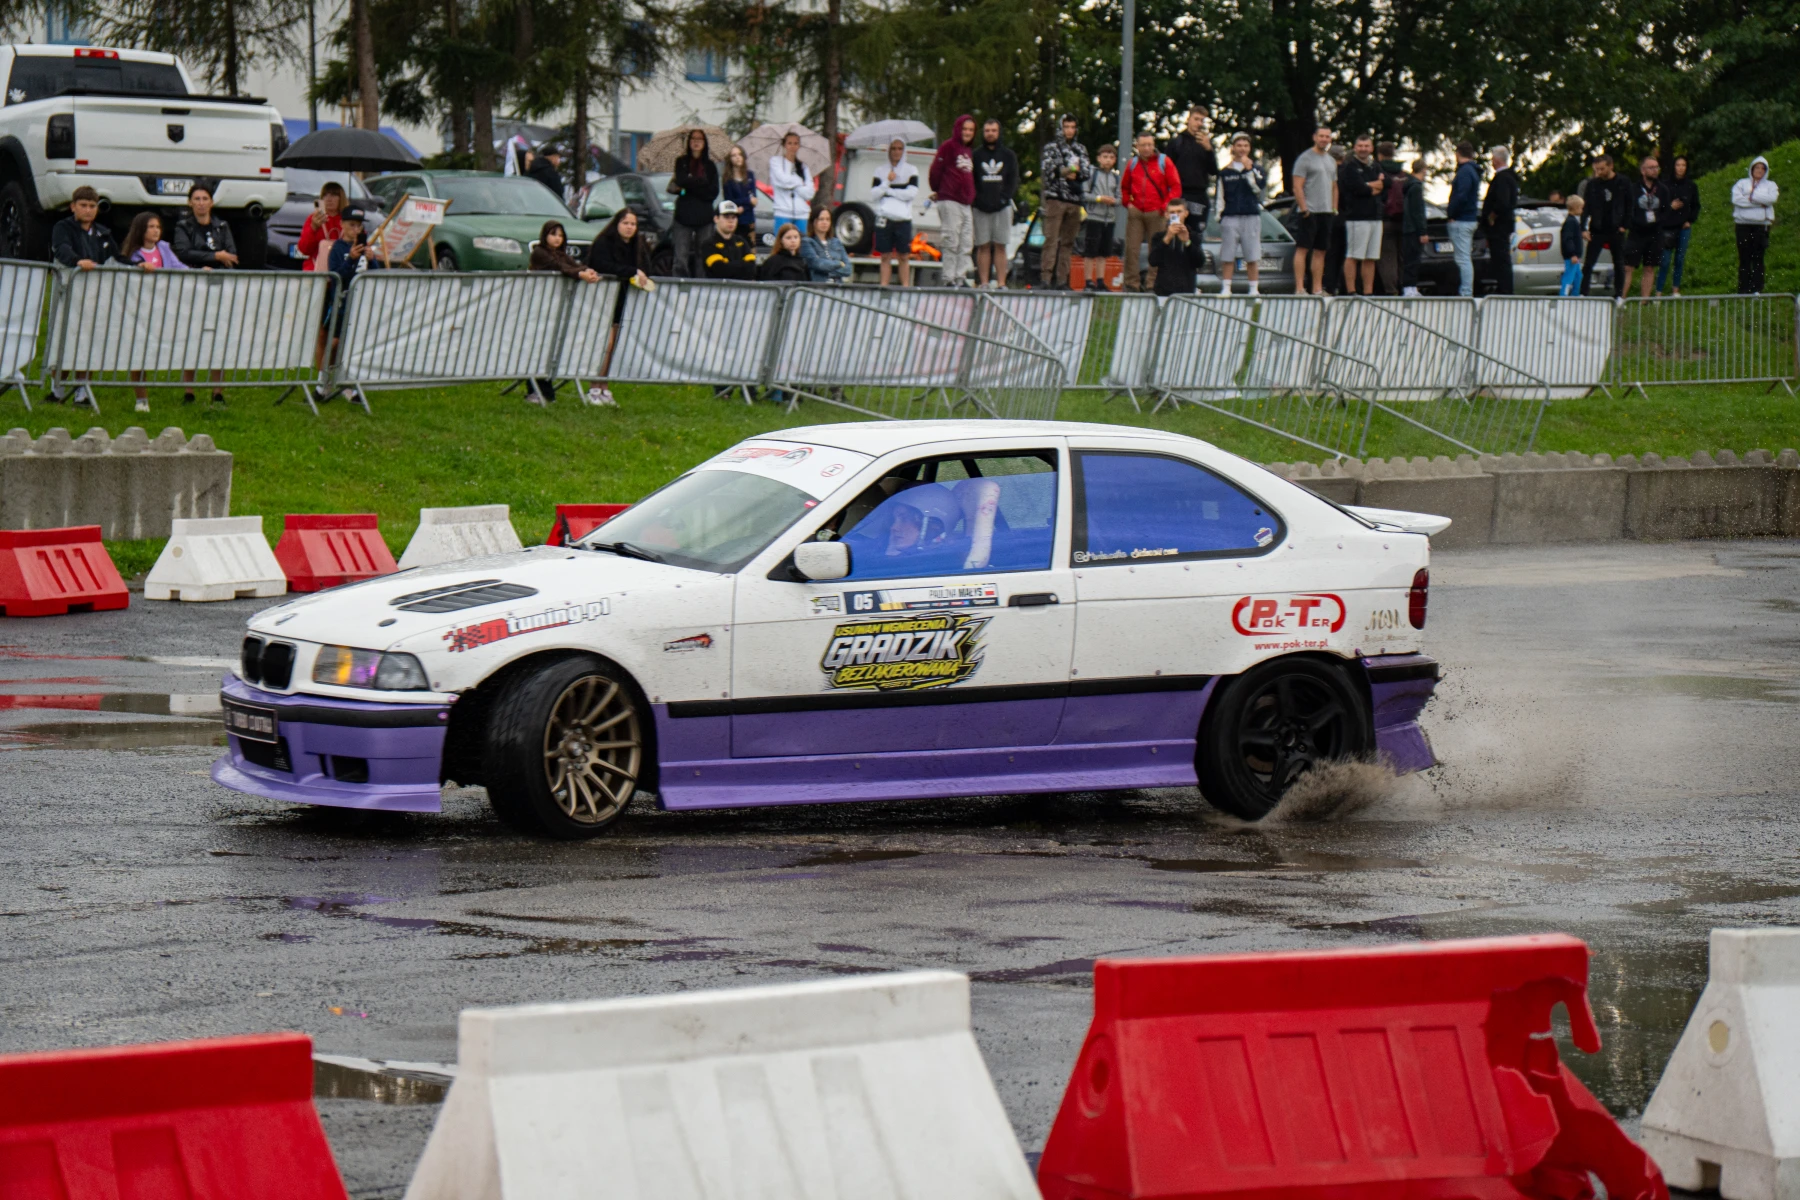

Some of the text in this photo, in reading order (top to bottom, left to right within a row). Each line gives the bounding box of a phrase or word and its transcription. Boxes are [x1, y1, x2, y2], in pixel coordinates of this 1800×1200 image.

[853, 593, 874, 611] 05
[929, 588, 956, 599] PAULINA
[835, 619, 946, 636] USUWAM WGNIECENIA
[823, 629, 967, 669] GRADZIK
[1254, 638, 1328, 651] www.pok-ter.pl
[837, 661, 959, 682] BEZ LAKIEROWANIA
